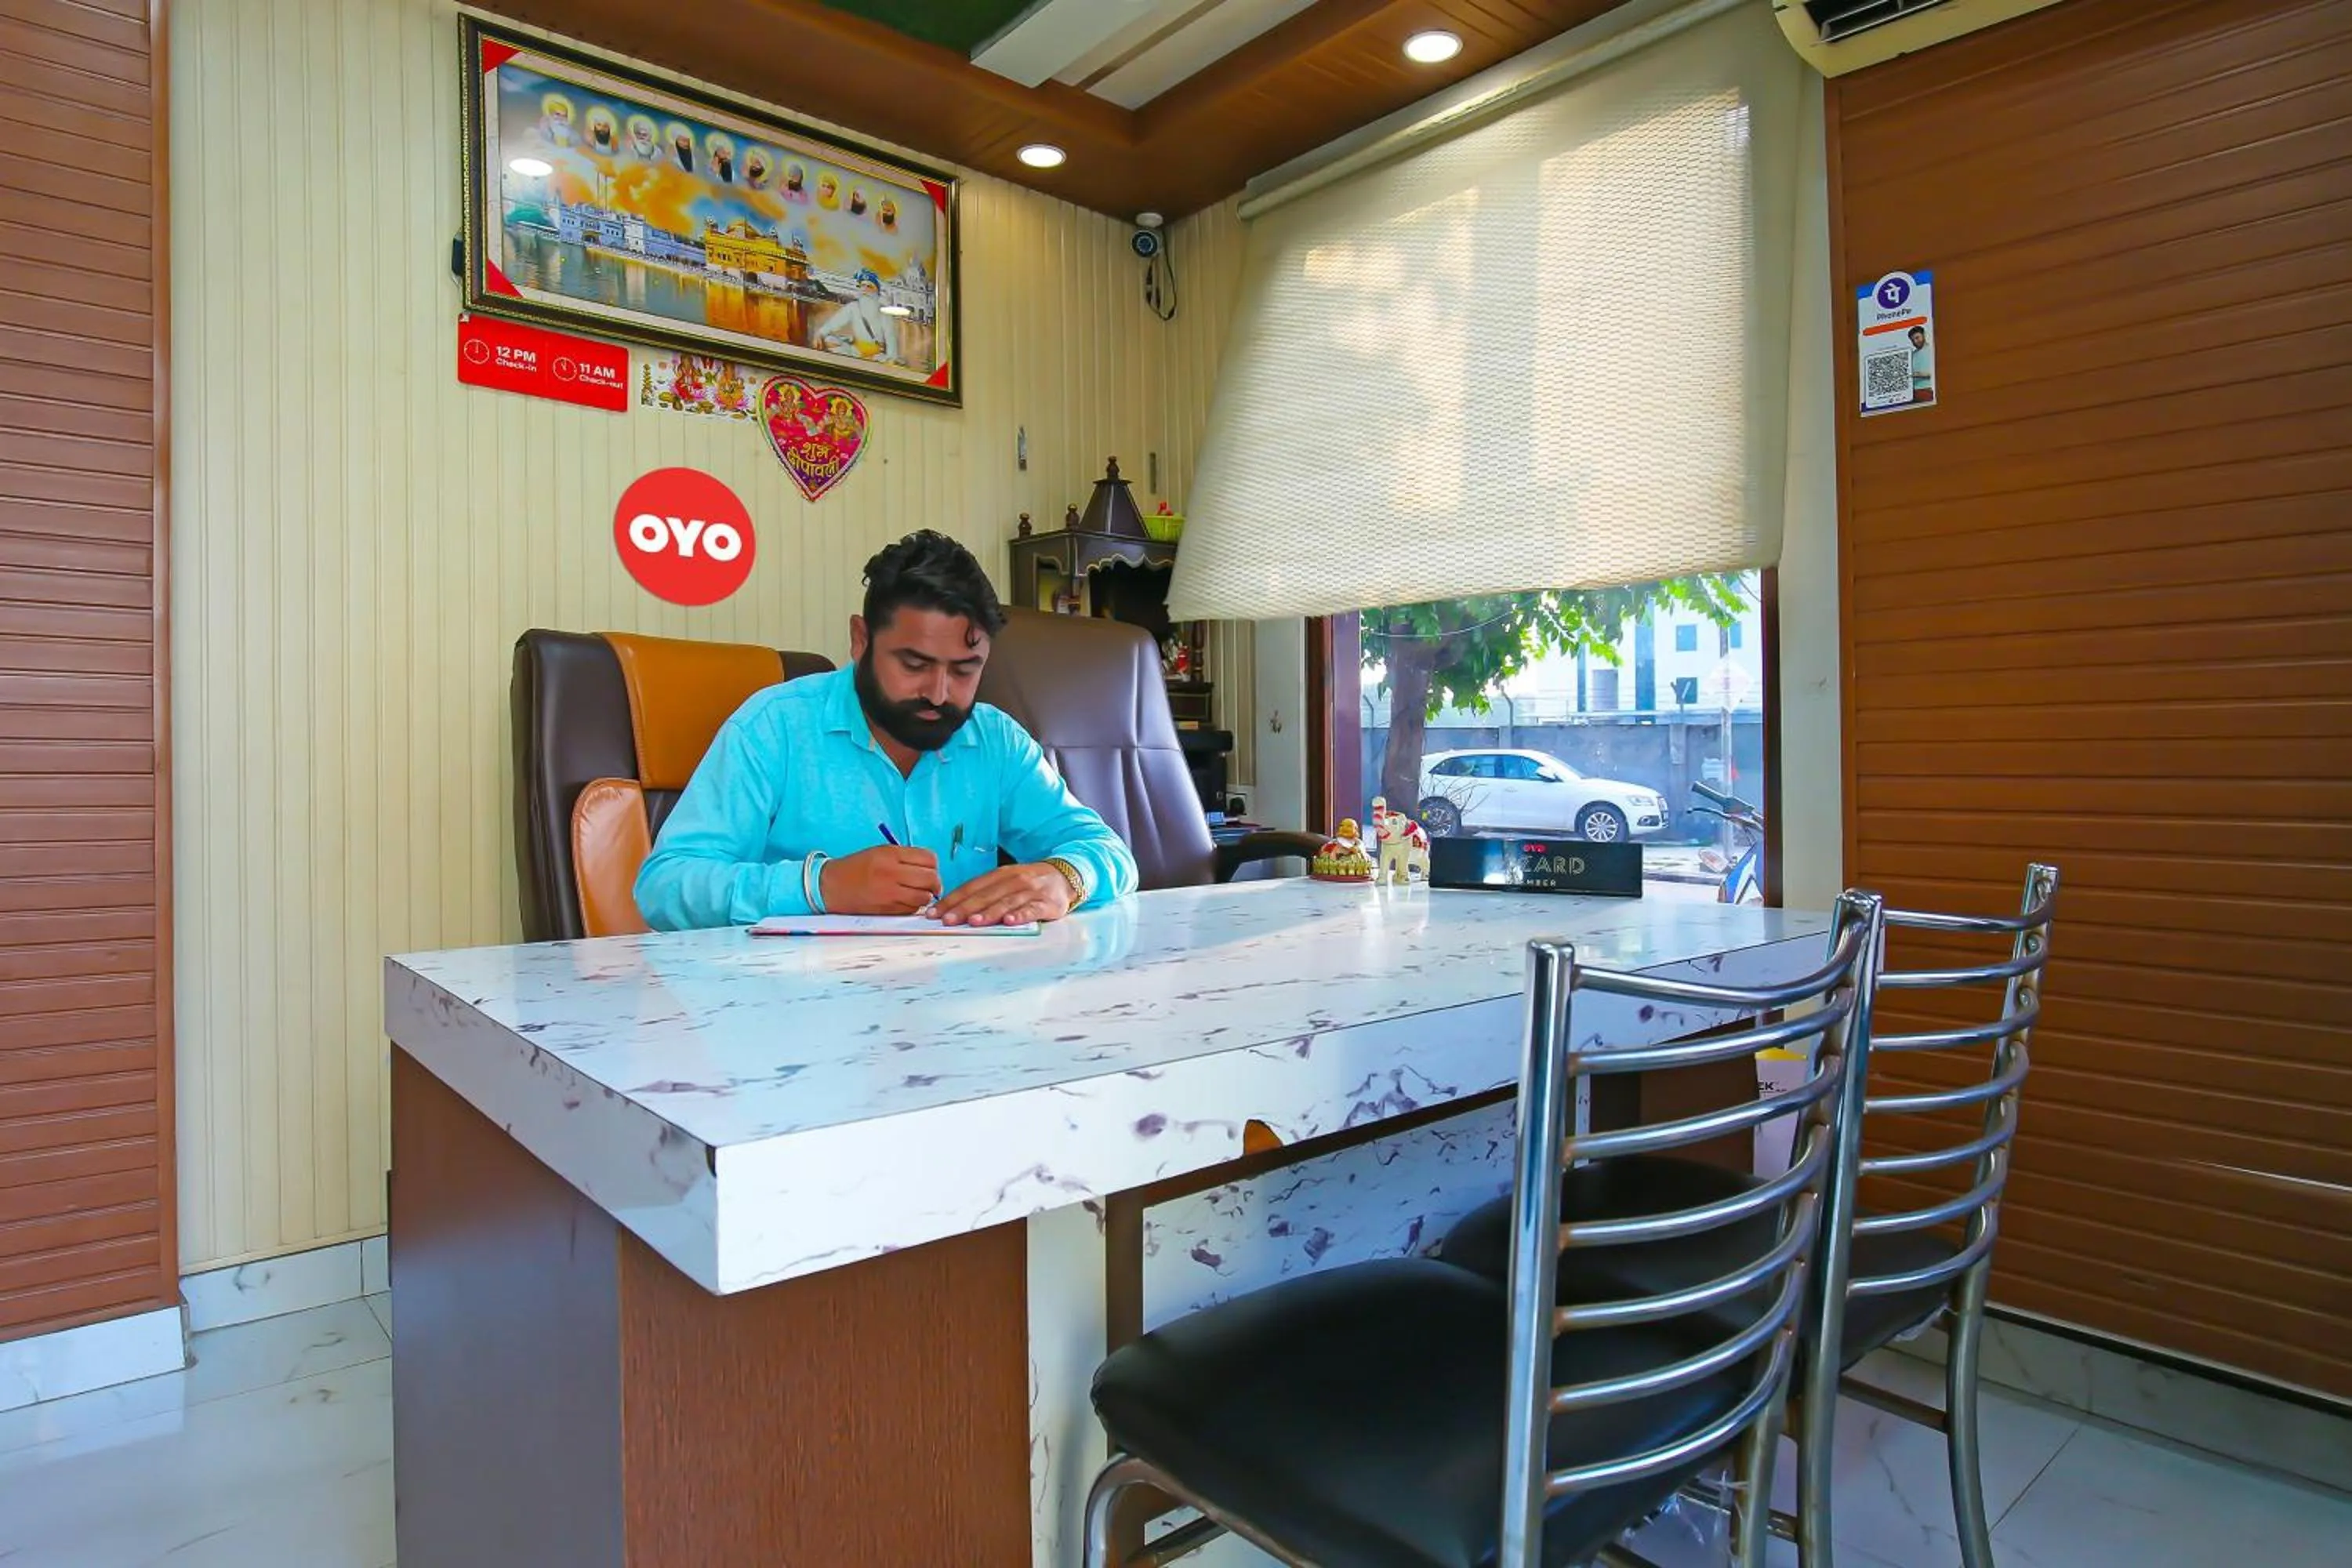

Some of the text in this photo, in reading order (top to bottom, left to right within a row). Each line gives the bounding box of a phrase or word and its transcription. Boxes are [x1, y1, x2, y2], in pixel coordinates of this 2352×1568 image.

[495, 346, 536, 363] 12 PM
[495, 358, 537, 372] Check-in
[579, 363, 615, 379] 11 AM
[579, 374, 623, 389] Check-out
[800, 441, 832, 462] शुभ
[629, 514, 742, 562] OYO
